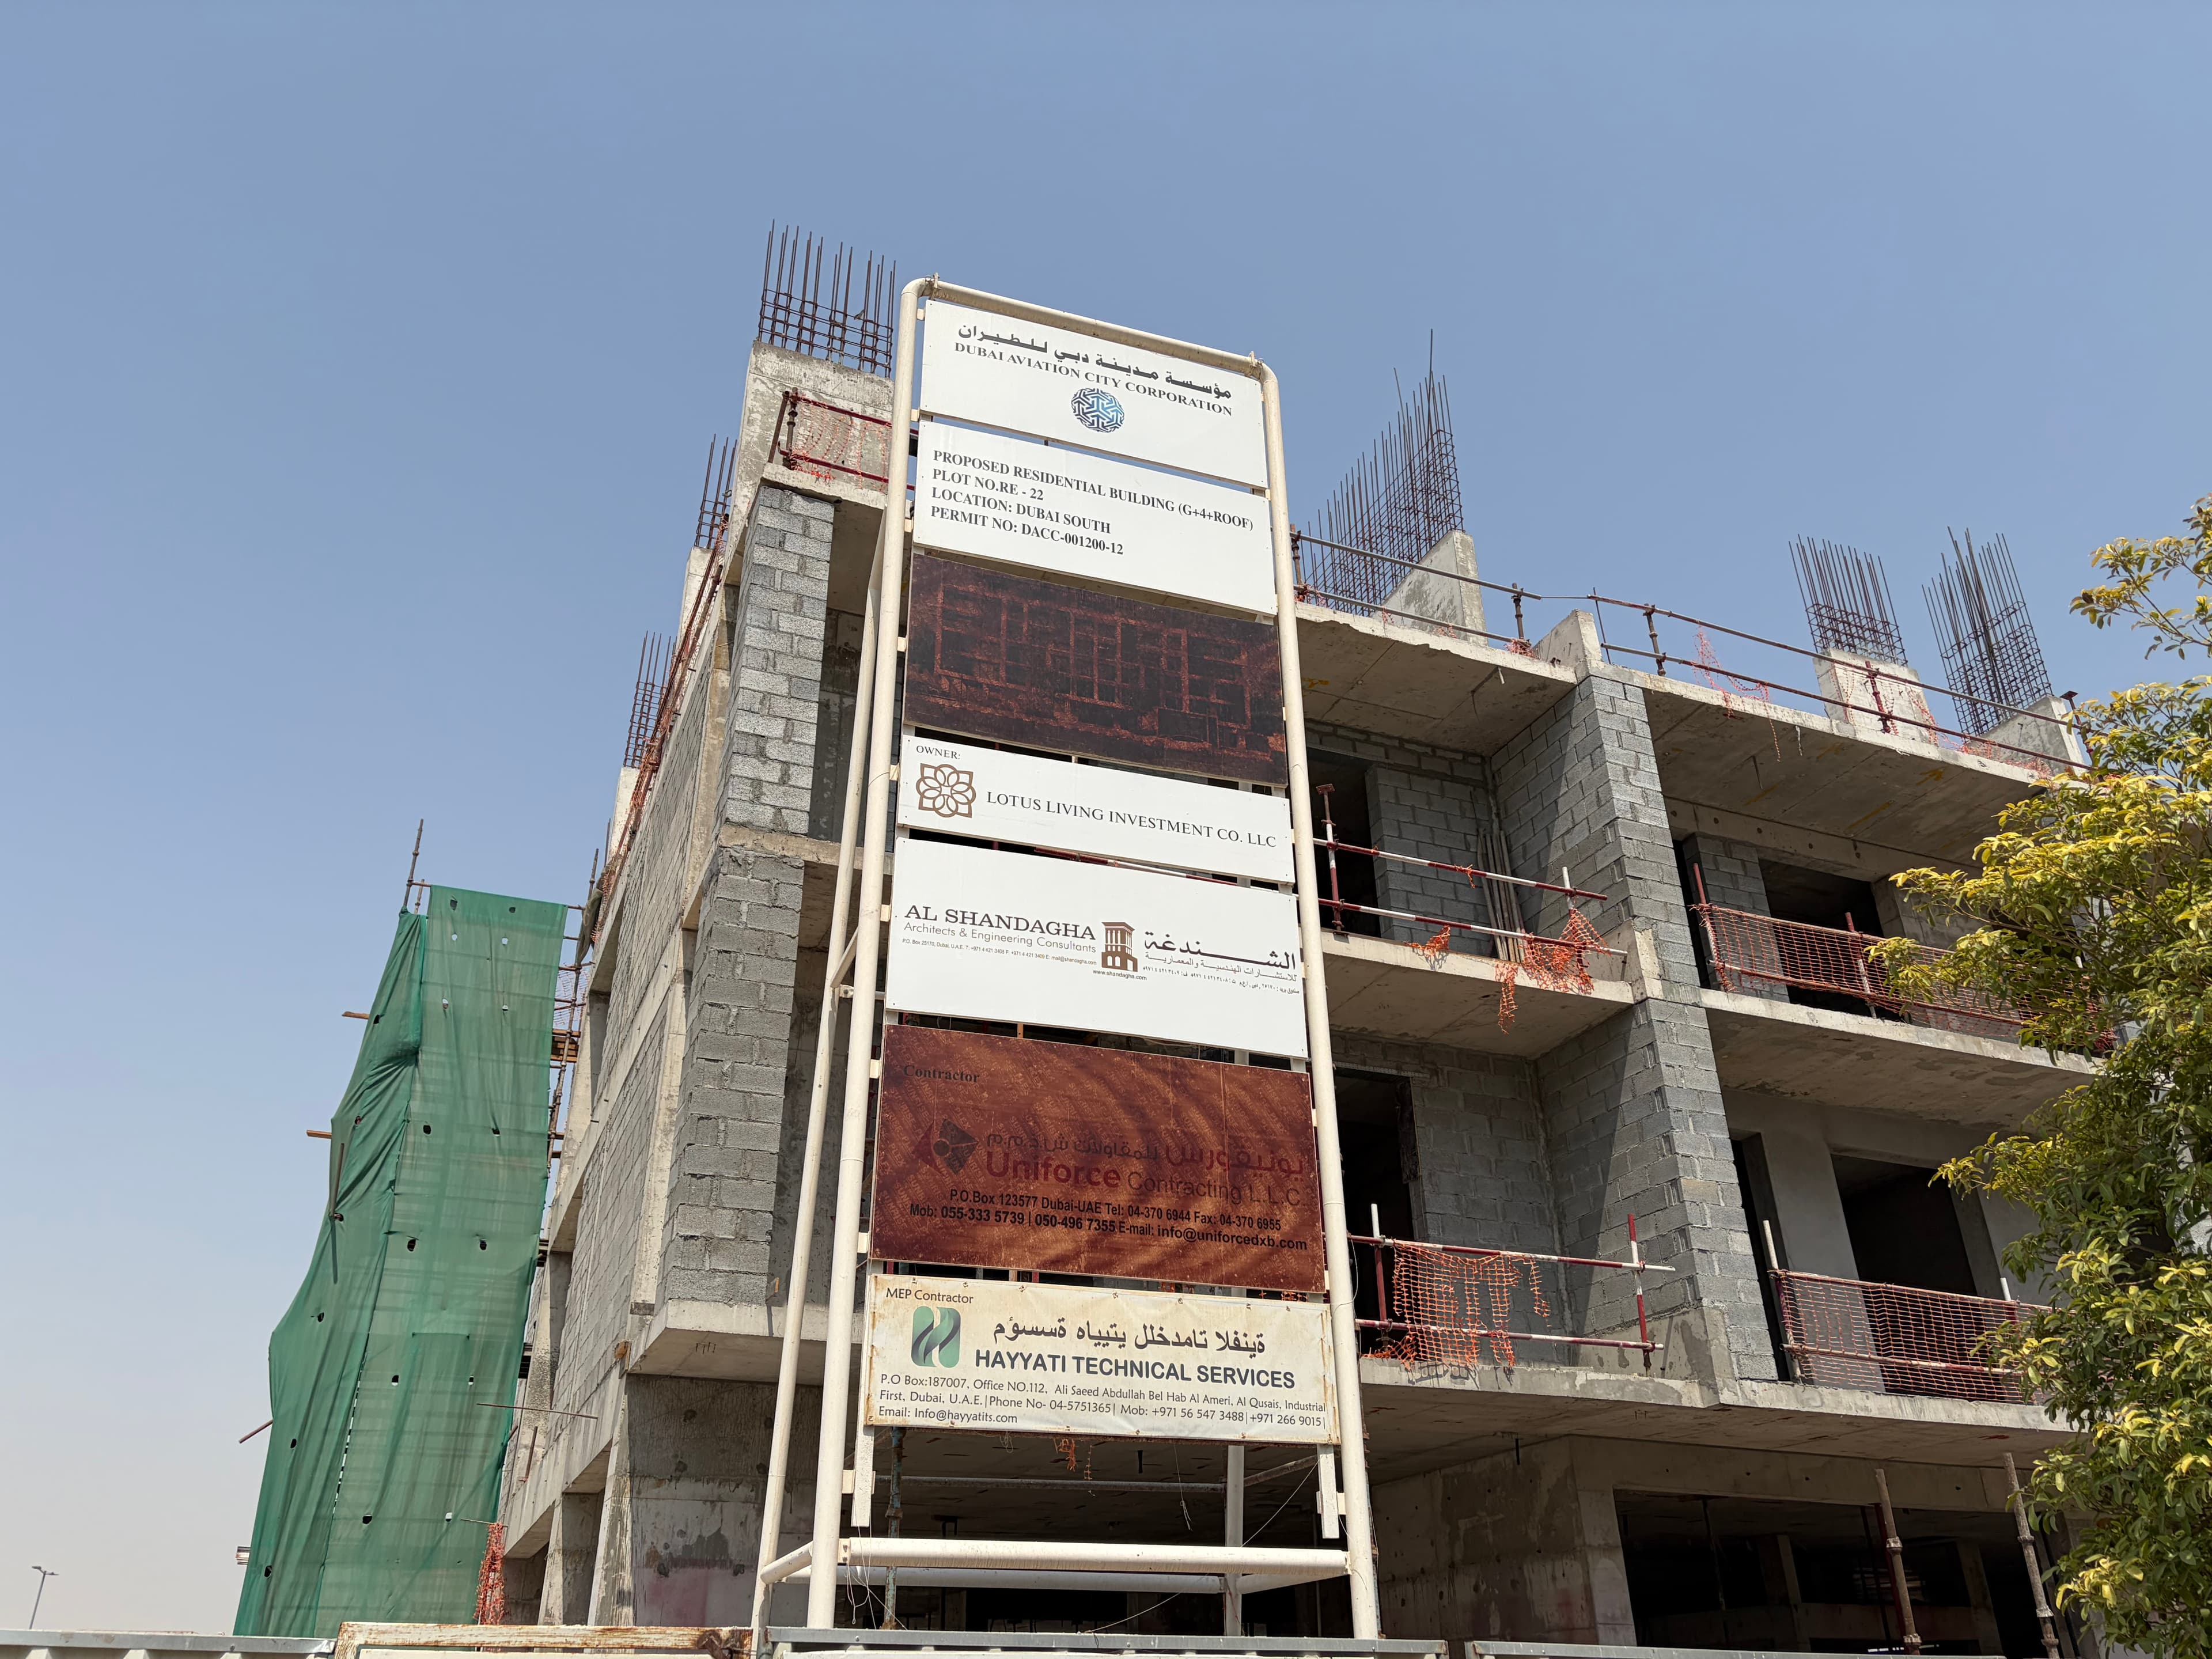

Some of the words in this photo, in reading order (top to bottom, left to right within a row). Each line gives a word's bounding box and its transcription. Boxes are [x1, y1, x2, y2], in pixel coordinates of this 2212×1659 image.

[958, 325, 1048, 354] للطيران
[1054, 349, 1089, 364] دبي
[955, 342, 1003, 361] DUBAI
[1007, 354, 1080, 378] AVIATION
[1084, 372, 1121, 388] CITY
[1125, 382, 1232, 416] CORPORATION
[1095, 354, 1159, 381] مدينة
[1165, 371, 1232, 399] مؤسسة
[933, 468, 971, 486] PLOT
[1029, 488, 1044, 501] 22
[933, 450, 1010, 475] PROPOSED
[1013, 465, 1106, 497] RESIDENTIAL
[1109, 487, 1175, 512] BUILDING
[1178, 503, 1253, 531] (G+4+ROOF)
[931, 487, 1012, 513] LOCATION:
[1016, 503, 1060, 523] DUBAI
[1063, 513, 1111, 534] SOUTH
[930, 506, 988, 527] PERMIT
[992, 517, 1017, 533] NO:
[1021, 523, 1123, 555] DACC-001200-12
[916, 745, 960, 760] OWNER:
[987, 791, 1041, 810] LOTUS
[1046, 801, 1104, 820] LIVING
[1109, 810, 1213, 838] INVESTMENT
[1217, 828, 1243, 843] CO.
[1248, 832, 1276, 847] LLC
[904, 905, 937, 921] AL
[945, 908, 1096, 941] SHANDAGHA
[904, 922, 956, 936] Architects
[959, 927, 968, 938] &
[971, 929, 1033, 948] Engineering
[1036, 937, 1096, 953] Consultants
[1144, 931, 1296, 970] الشندغة
[1092, 969, 1147, 981] www.shandagha.com
[903, 1065, 980, 1084] Contractor
[986, 1151, 1121, 1189] Uniforce
[1127, 1171, 1242, 1205] Contracting
[910, 1203, 937, 1218] Mob:
[941, 1206, 990, 1222] 055-333
[994, 1210, 1025, 1226] 5739
[1033, 1213, 1083, 1231] 050-496
[1086, 1218, 1118, 1236] 7355
[1118, 1219, 1154, 1240] E-mail:
[1157, 1224, 1308, 1252] info@uniforcedxb.com
[950, 1188, 995, 1205] P.O.Box
[998, 1193, 1038, 1211] 123577
[1041, 1196, 1104, 1217] Dubai-UAE
[1104, 1202, 1127, 1219] Tel:
[1126, 1205, 1163, 1219] 04-370
[1166, 1208, 1191, 1222] 6944
[1194, 1211, 1218, 1228] Fax:
[1218, 1211, 1254, 1229] 04-370
[1256, 1214, 1282, 1232] 6955
[885, 1287, 912, 1300] MEP
[914, 1289, 974, 1304] Contractor
[975, 1349, 1066, 1373] HAYYATI
[1071, 1355, 1192, 1381] TECHNICAL
[1196, 1365, 1296, 1389] SERVICES
[880, 1389, 906, 1402] First,
[910, 1391, 945, 1404] Dubai,
[1026, 1398, 1047, 1409] No-
[1120, 1404, 1148, 1416] Mob:
[1152, 1406, 1176, 1417] +971
[1180, 1408, 1194, 1418] 56
[1196, 1409, 1216, 1420] 547
[1277, 1414, 1296, 1425] 266
[881, 1373, 901, 1385] P.O
[973, 1379, 1004, 1391] Office
[1007, 1381, 1048, 1394] NO.112,
[1054, 1384, 1068, 1395] Ali
[1071, 1385, 1099, 1397] Saeed
[1101, 1387, 1145, 1400] Abdullah
[1149, 1390, 1163, 1401] Bel
[1166, 1391, 1187, 1403] Hab
[1189, 1393, 1199, 1403] Al
[1202, 1394, 1233, 1407] Ameri,
[1236, 1396, 1246, 1407] Al
[1249, 1397, 1282, 1410] Qusais,
[1285, 1399, 1327, 1412] Industrial
[878, 1406, 911, 1418] Email:
[915, 1407, 1017, 1424] Info@hayyatits.com
